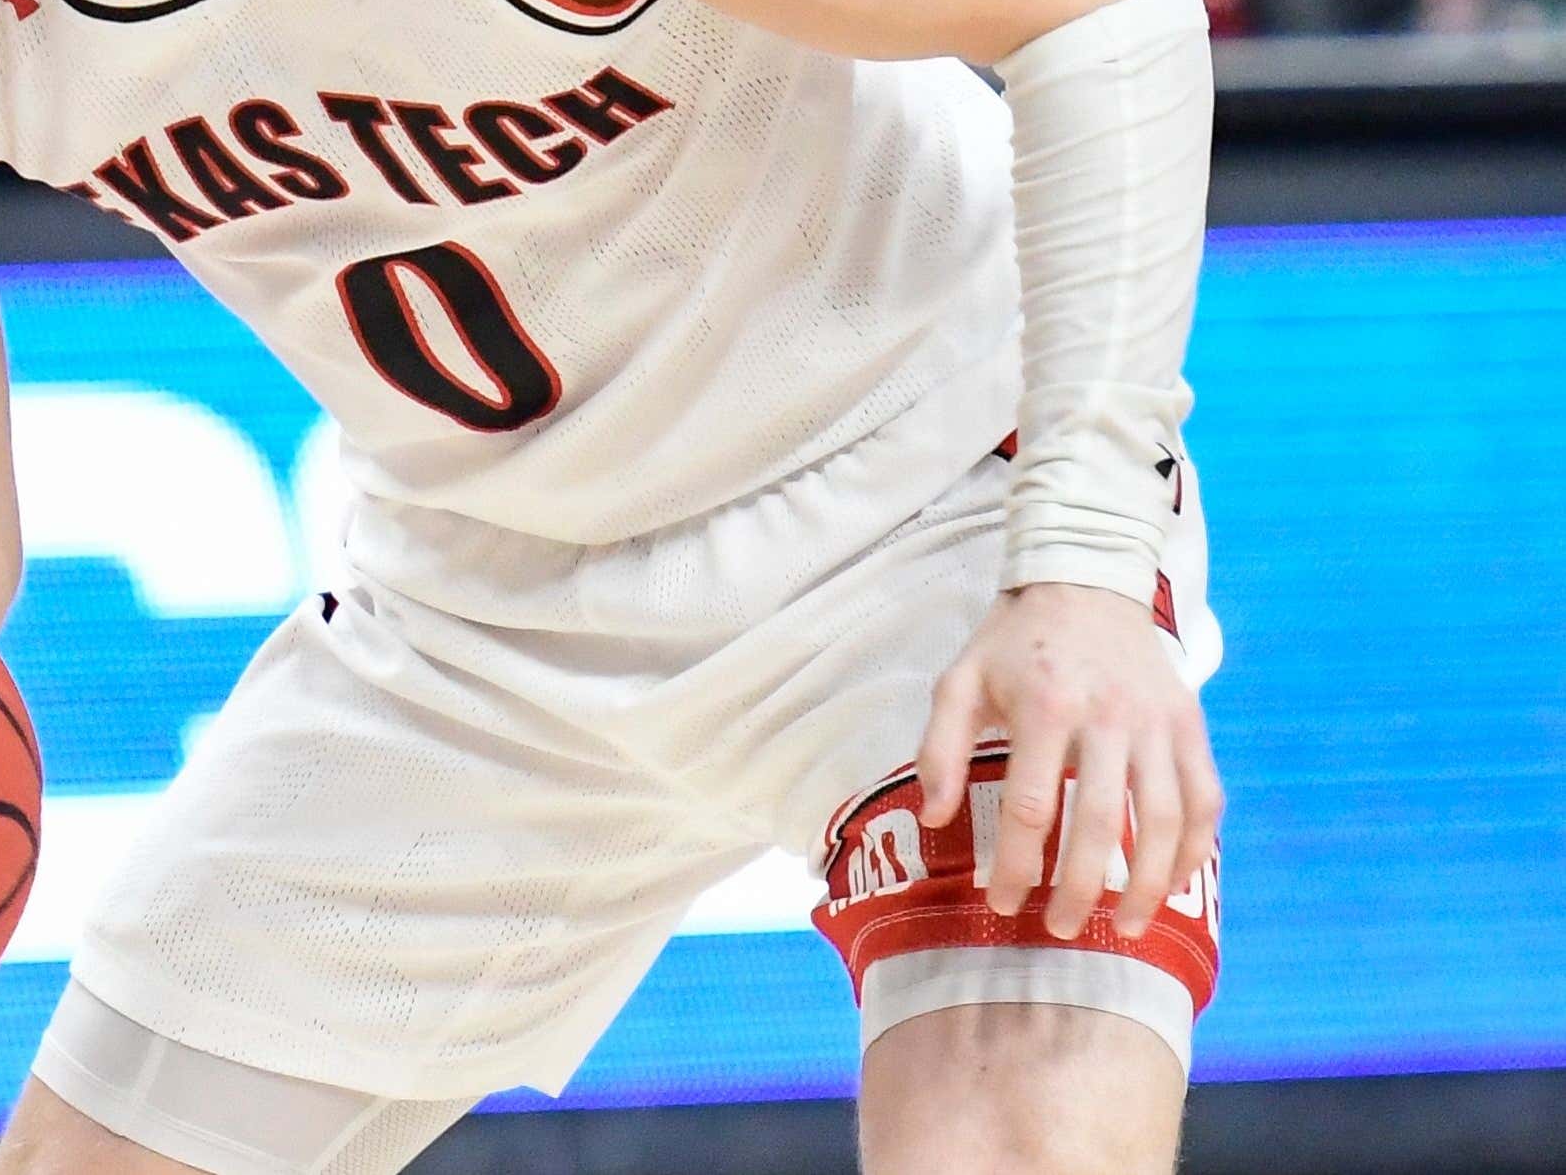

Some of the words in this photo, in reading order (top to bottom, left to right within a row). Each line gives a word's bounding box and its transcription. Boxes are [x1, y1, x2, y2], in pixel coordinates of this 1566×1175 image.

[56, 98, 349, 243] XAS
[316, 66, 675, 206] TECH
[335, 240, 562, 433] 0
